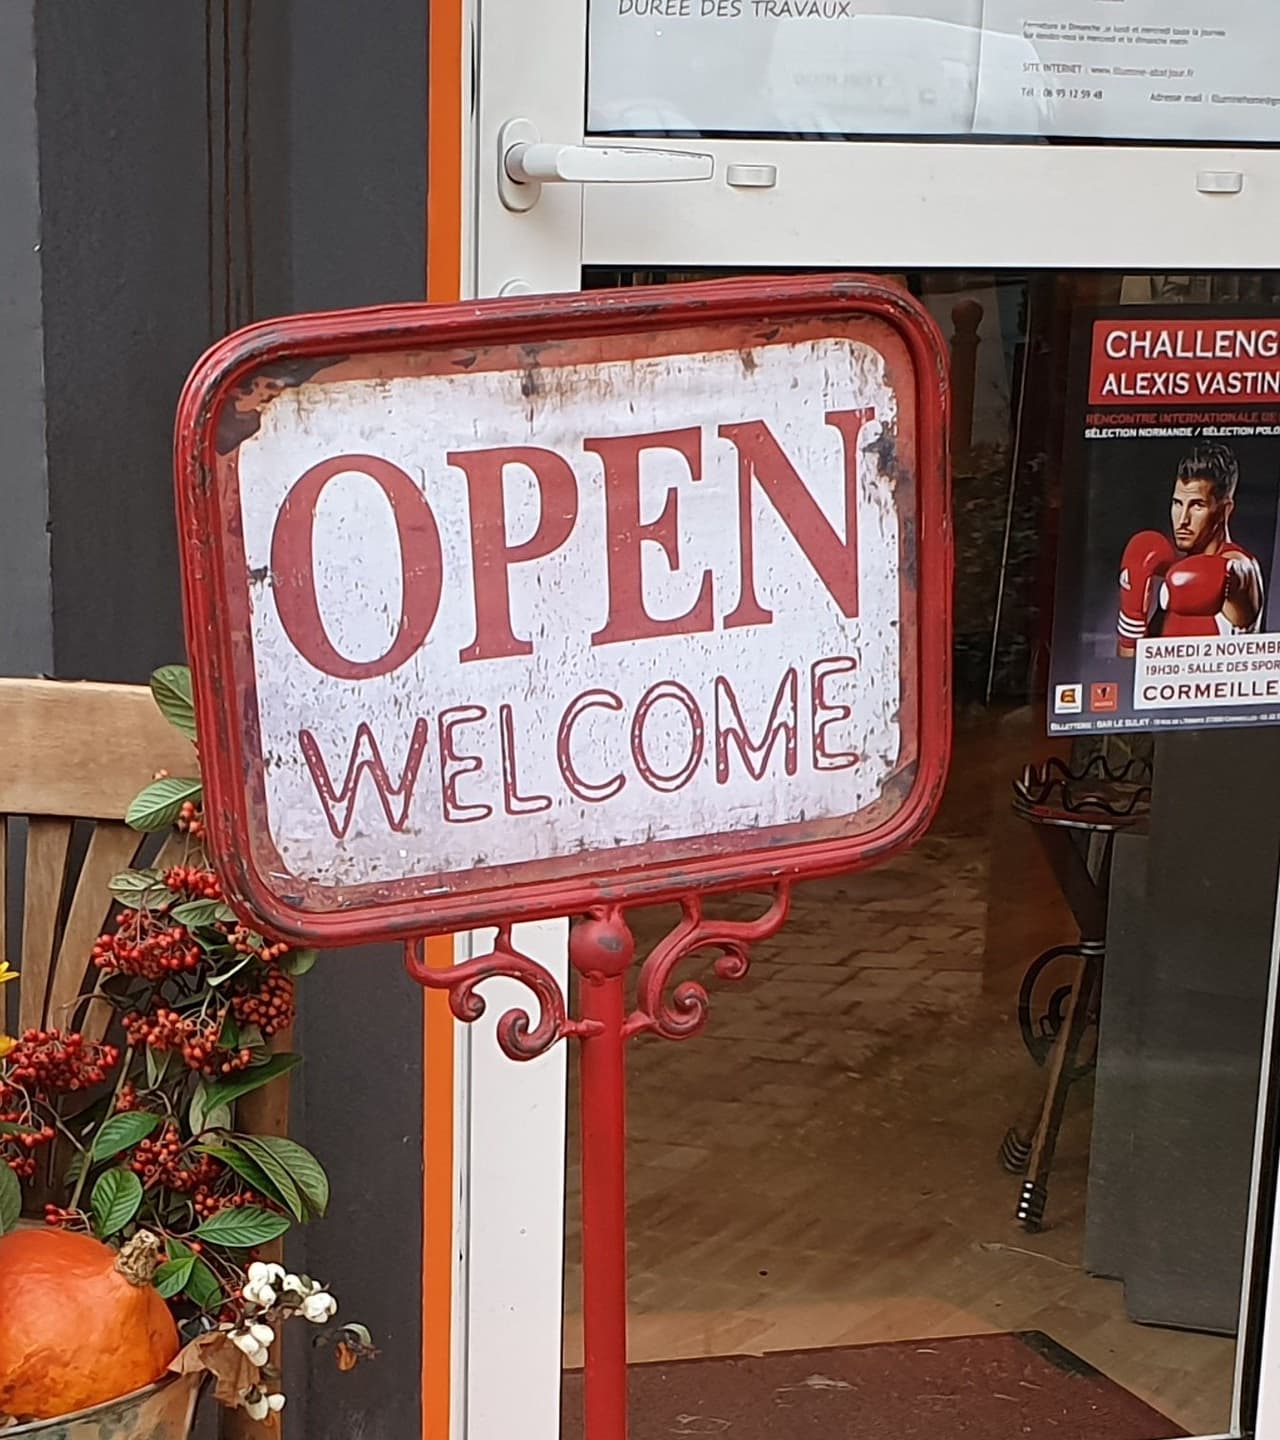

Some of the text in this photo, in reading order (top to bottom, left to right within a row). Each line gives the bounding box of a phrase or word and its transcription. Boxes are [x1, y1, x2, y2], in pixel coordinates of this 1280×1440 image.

[700, 0, 742, 17] DES
[1022, 62, 1040, 72] SITE
[1042, 63, 1082, 74] INTERNET
[1101, 371, 1190, 397] ALEXIS
[1085, 411, 1156, 425] RENCONTRE
[1158, 410, 1260, 424] INTERNATIONALE
[1084, 425, 1137, 439] SÉLECTION
[1138, 425, 1192, 438] NORMANDE
[1202, 424, 1254, 438] SÉLECTION
[270, 407, 876, 681] OPEN
[1144, 643, 1200, 661] SAMEDI
[1202, 642, 1213, 658] 2
[1145, 662, 1179, 676] 19H30
[1187, 660, 1225, 675] SALLE
[1227, 659, 1249, 673] DES
[298, 656, 860, 840] WELCOME
